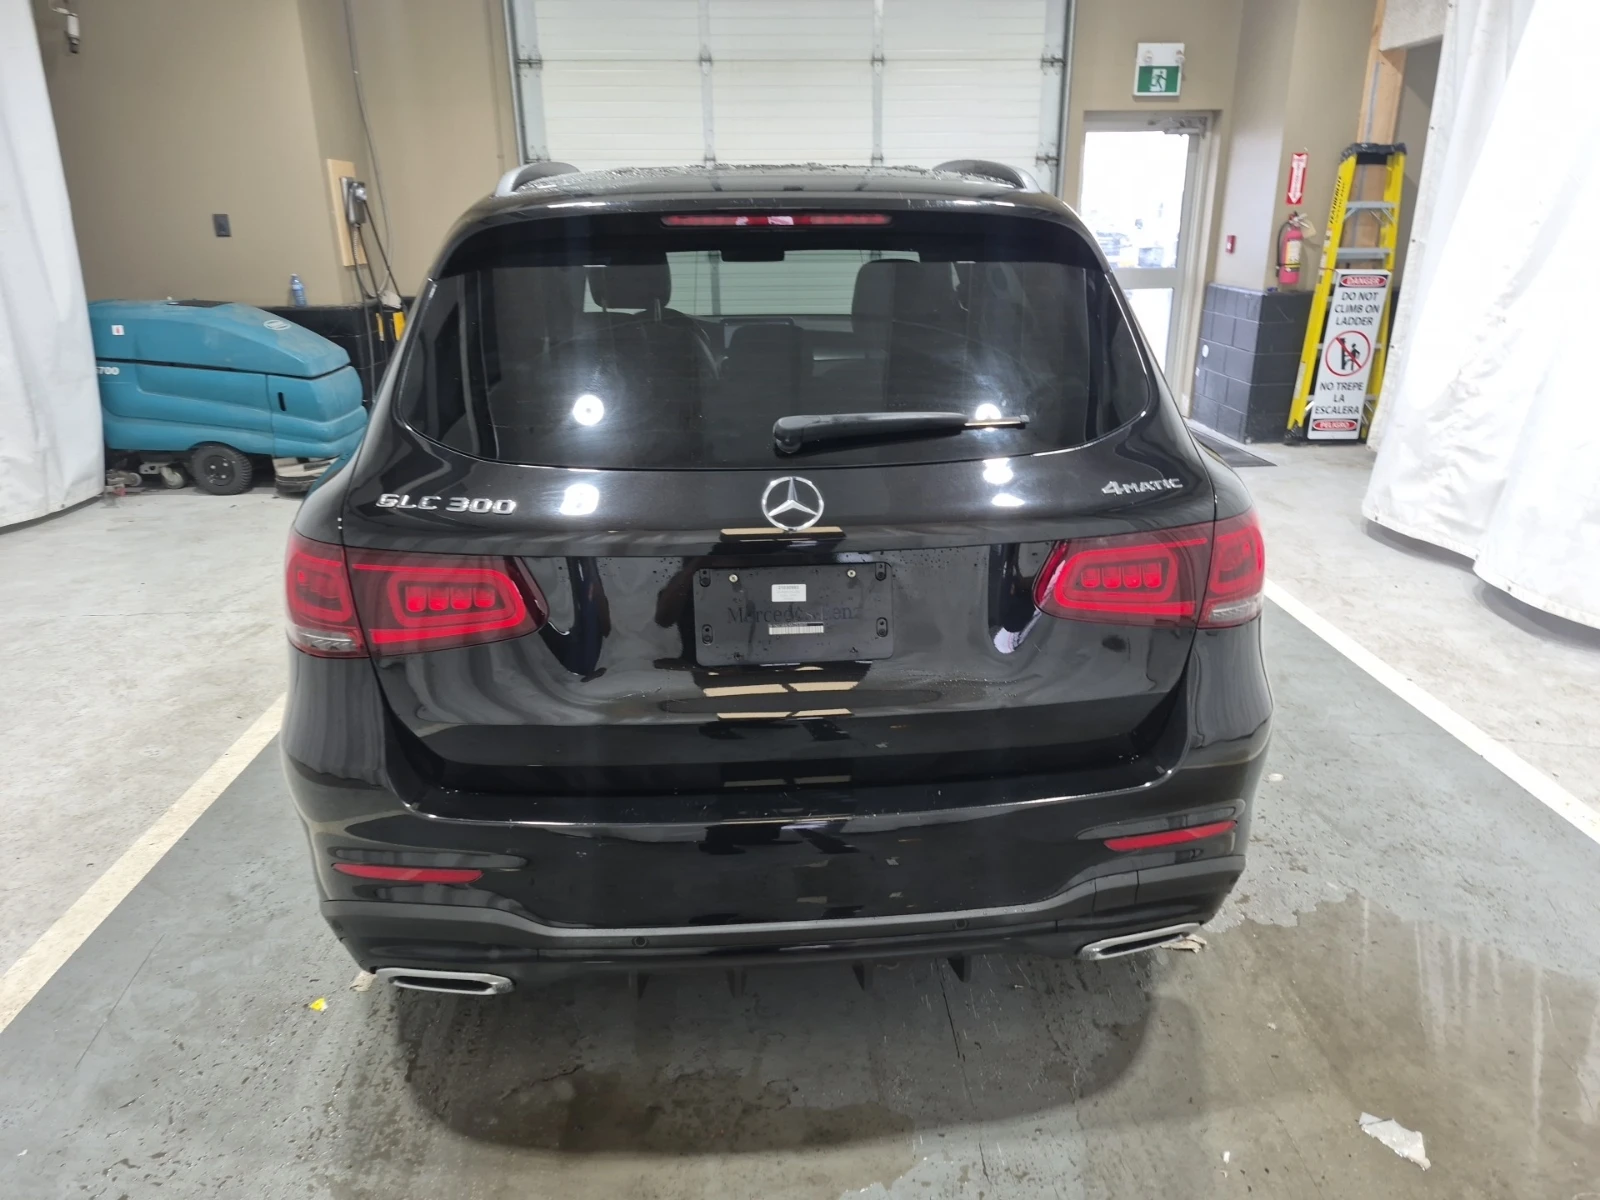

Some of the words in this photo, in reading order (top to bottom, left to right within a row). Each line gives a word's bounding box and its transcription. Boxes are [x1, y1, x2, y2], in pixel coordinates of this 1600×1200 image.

[1346, 276, 1379, 286] DANGER
[1341, 291, 1357, 301] DO
[1358, 291, 1379, 301] NOT
[1334, 304, 1364, 313] CLIMB
[1365, 304, 1380, 313] ON
[1335, 316, 1374, 326] LADDER
[1320, 382, 1334, 391] NO
[1336, 382, 1364, 391] TREPE
[1333, 393, 1345, 402] LA
[1315, 405, 1360, 415] ESCALERA
[1101, 478, 1183, 495] 4MATIC
[376, 493, 442, 510] GLC
[445, 496, 517, 515] 300
